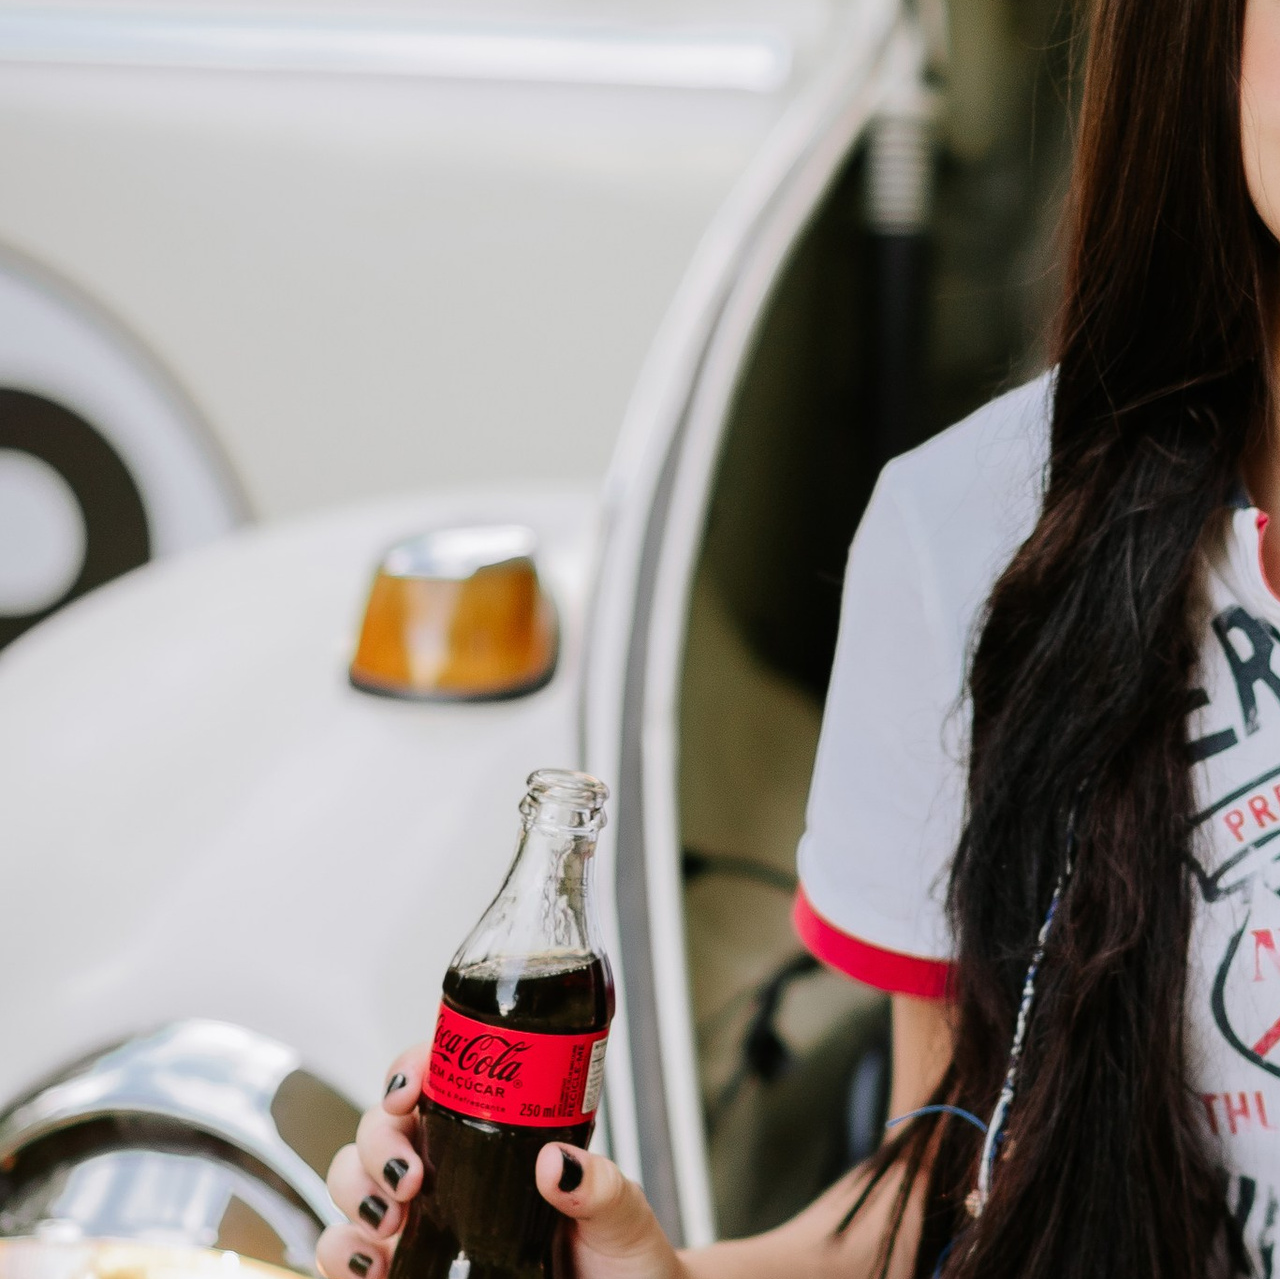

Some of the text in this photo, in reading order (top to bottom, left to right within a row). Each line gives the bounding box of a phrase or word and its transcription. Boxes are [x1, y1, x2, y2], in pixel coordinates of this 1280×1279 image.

[434, 1014, 534, 1082] oca-Cola
[447, 1073, 505, 1099] AÇÚCAR
[519, 1103, 556, 1118] 250 ml
